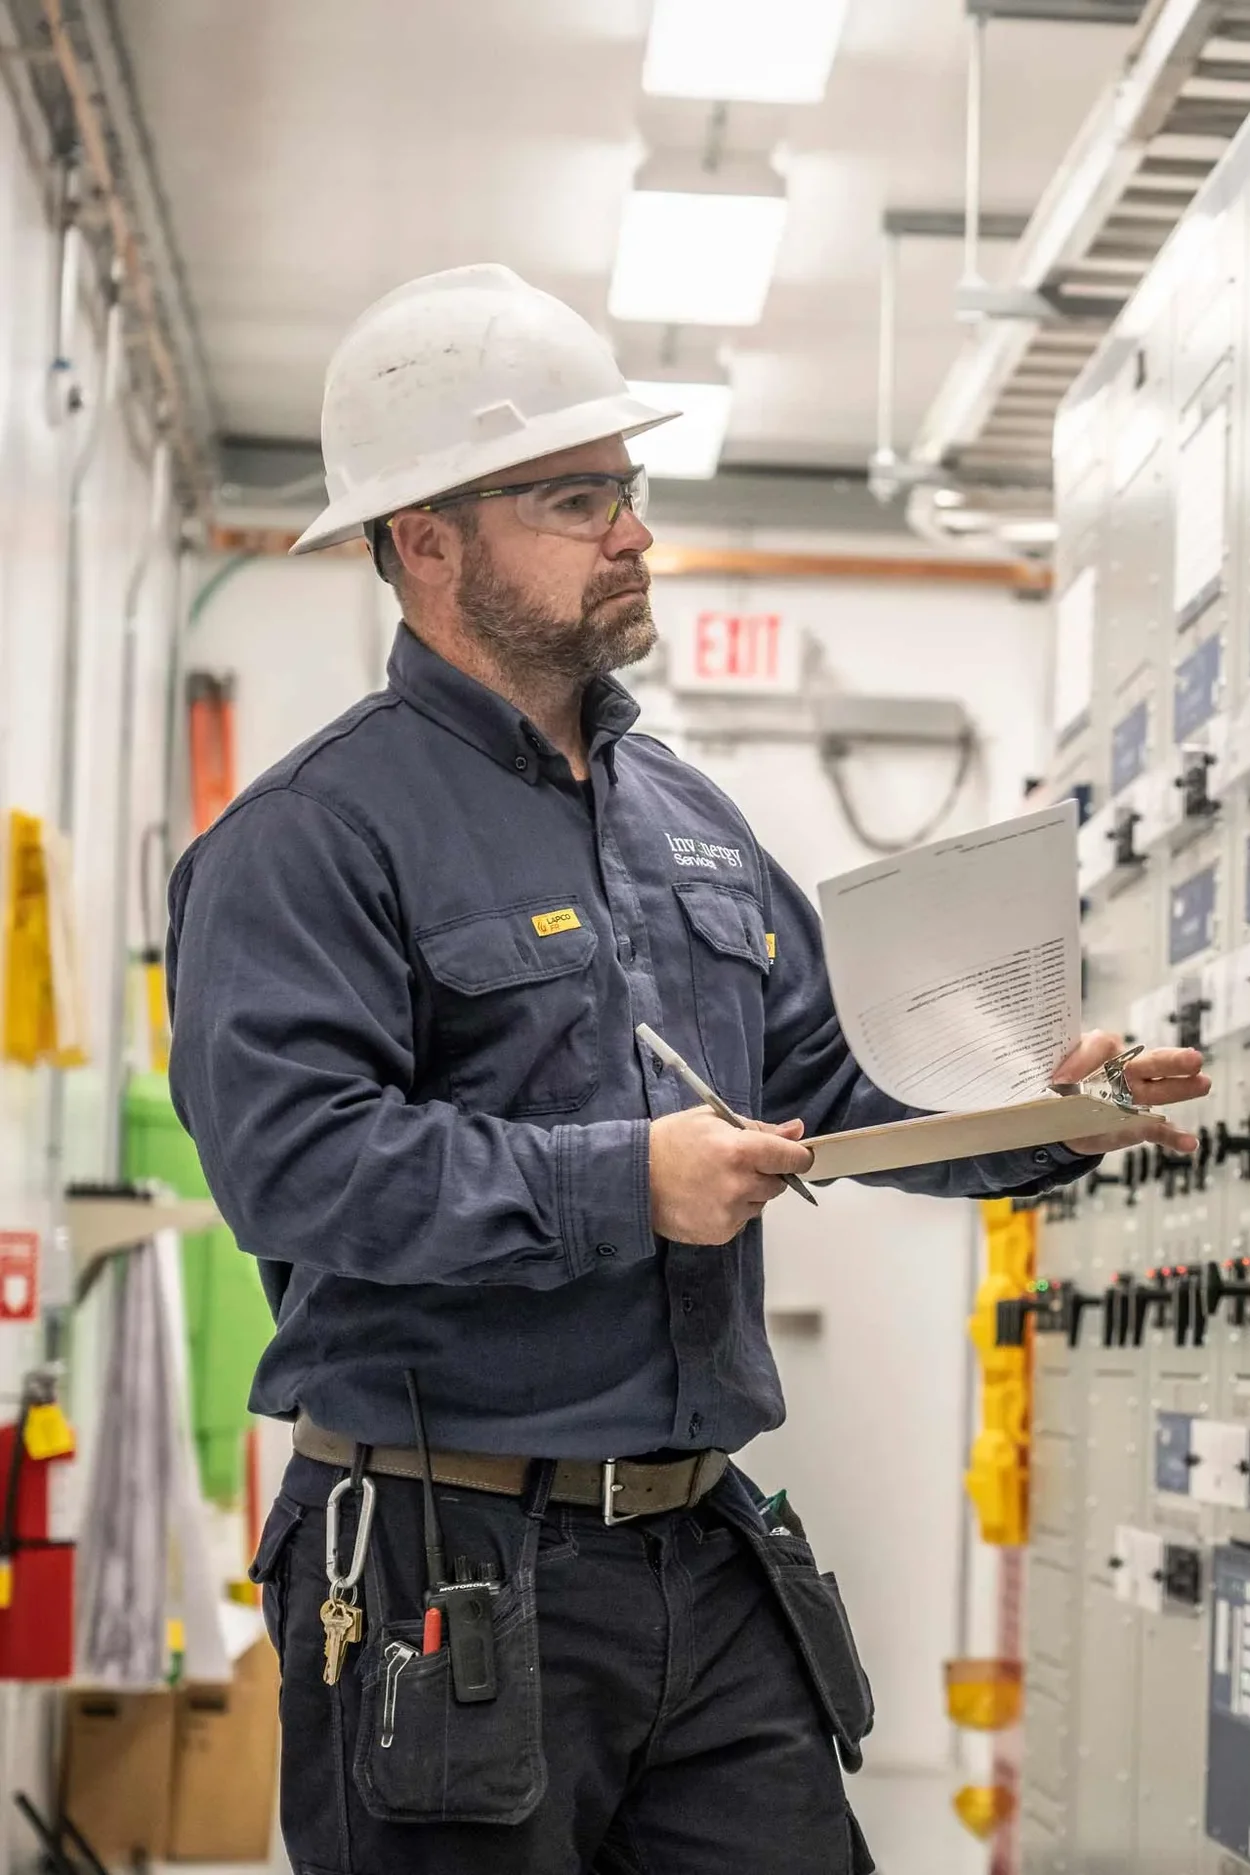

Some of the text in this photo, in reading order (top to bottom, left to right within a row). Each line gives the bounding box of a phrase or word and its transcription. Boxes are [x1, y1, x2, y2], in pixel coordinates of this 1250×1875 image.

[697, 612, 781, 680] EXIT
[547, 914, 571, 924] LAPCO
[439, 1582, 491, 1592] MOTOROLA
